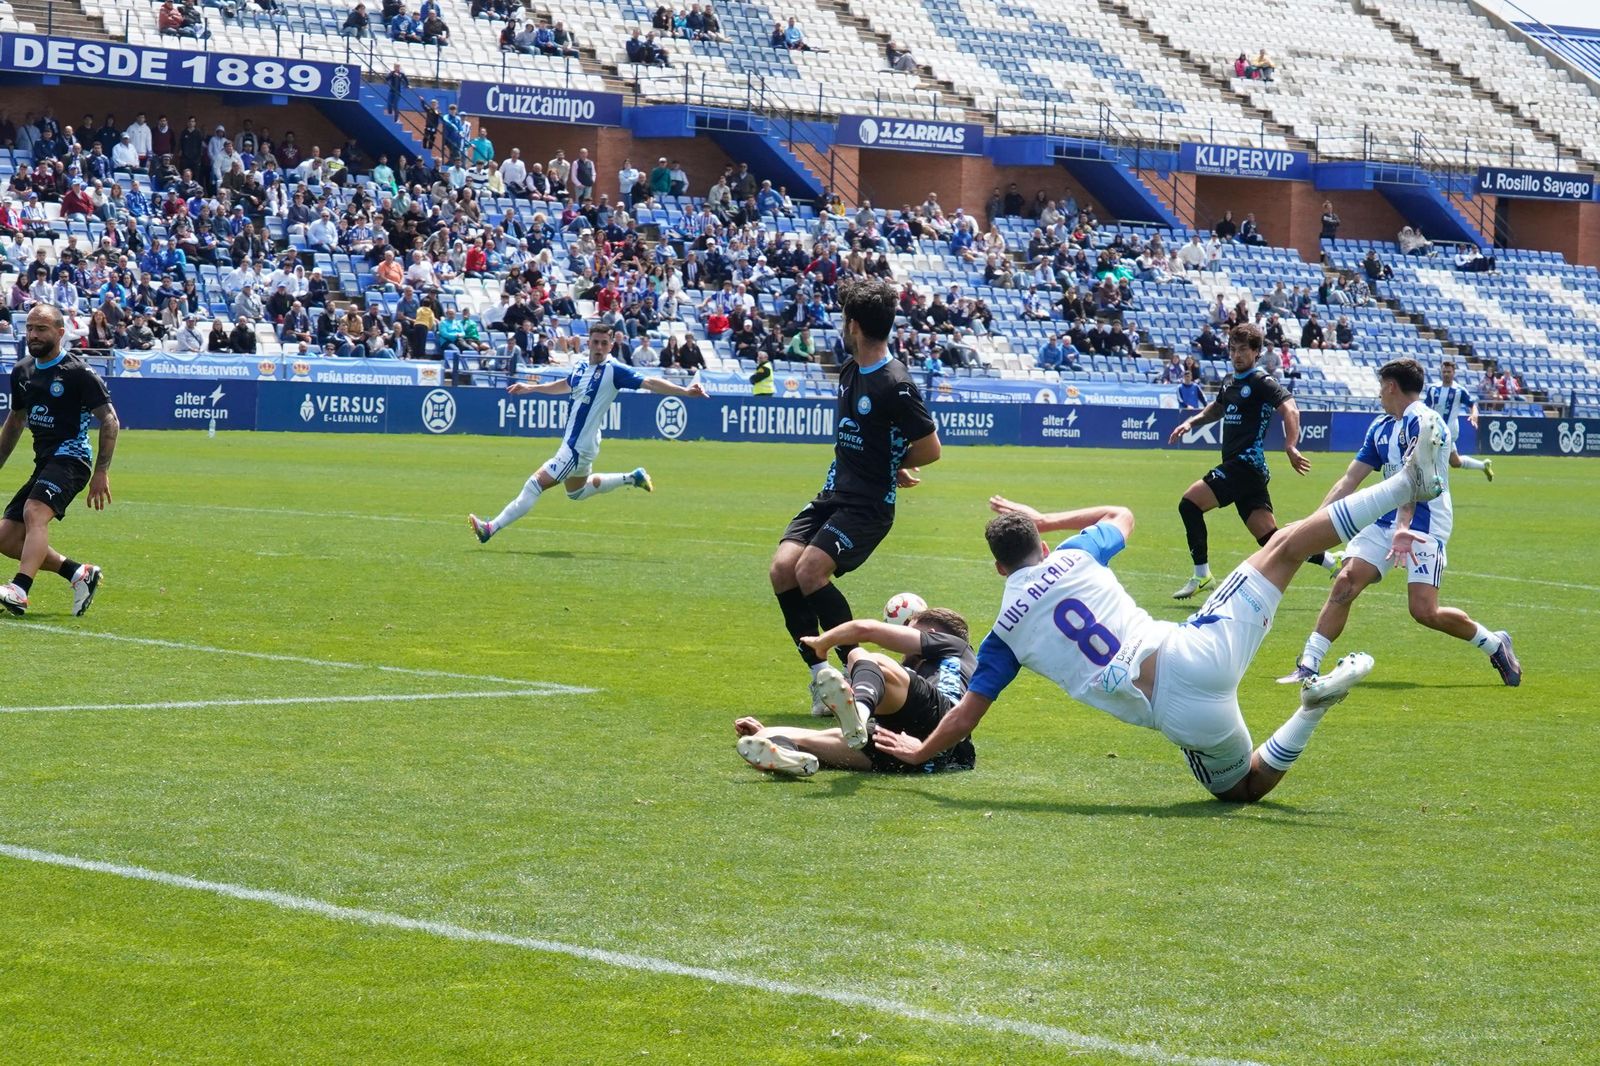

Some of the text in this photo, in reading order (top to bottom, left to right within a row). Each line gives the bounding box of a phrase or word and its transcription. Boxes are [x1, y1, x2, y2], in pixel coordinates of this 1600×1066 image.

[14, 37, 168, 81] DESDE
[181, 55, 322, 93] 1889
[486, 85, 596, 122] Cruzcampo
[1195, 145, 1295, 172] KLIPERVIP
[1481, 172, 1590, 199] J. Rosillo Sayago
[150, 361, 250, 376] PEÑA RECREATIVISTA
[317, 370, 413, 386] PEÑA RECREATIVISTA
[175, 391, 206, 405] alter
[316, 395, 385, 415] VERSUS
[174, 407, 228, 419] enersun
[323, 413, 378, 424] E-LEARNING
[740, 403, 834, 436] FEDERACIÓN
[940, 412, 994, 429] VERSUS
[1042, 414, 1065, 427] alter
[1121, 416, 1144, 429] alter
[945, 428, 989, 437] E-LEARNING
[1042, 427, 1081, 438] enersun
[1121, 429, 1160, 441] enersun
[997, 598, 1031, 633] LUIS
[1053, 598, 1122, 667] 8
